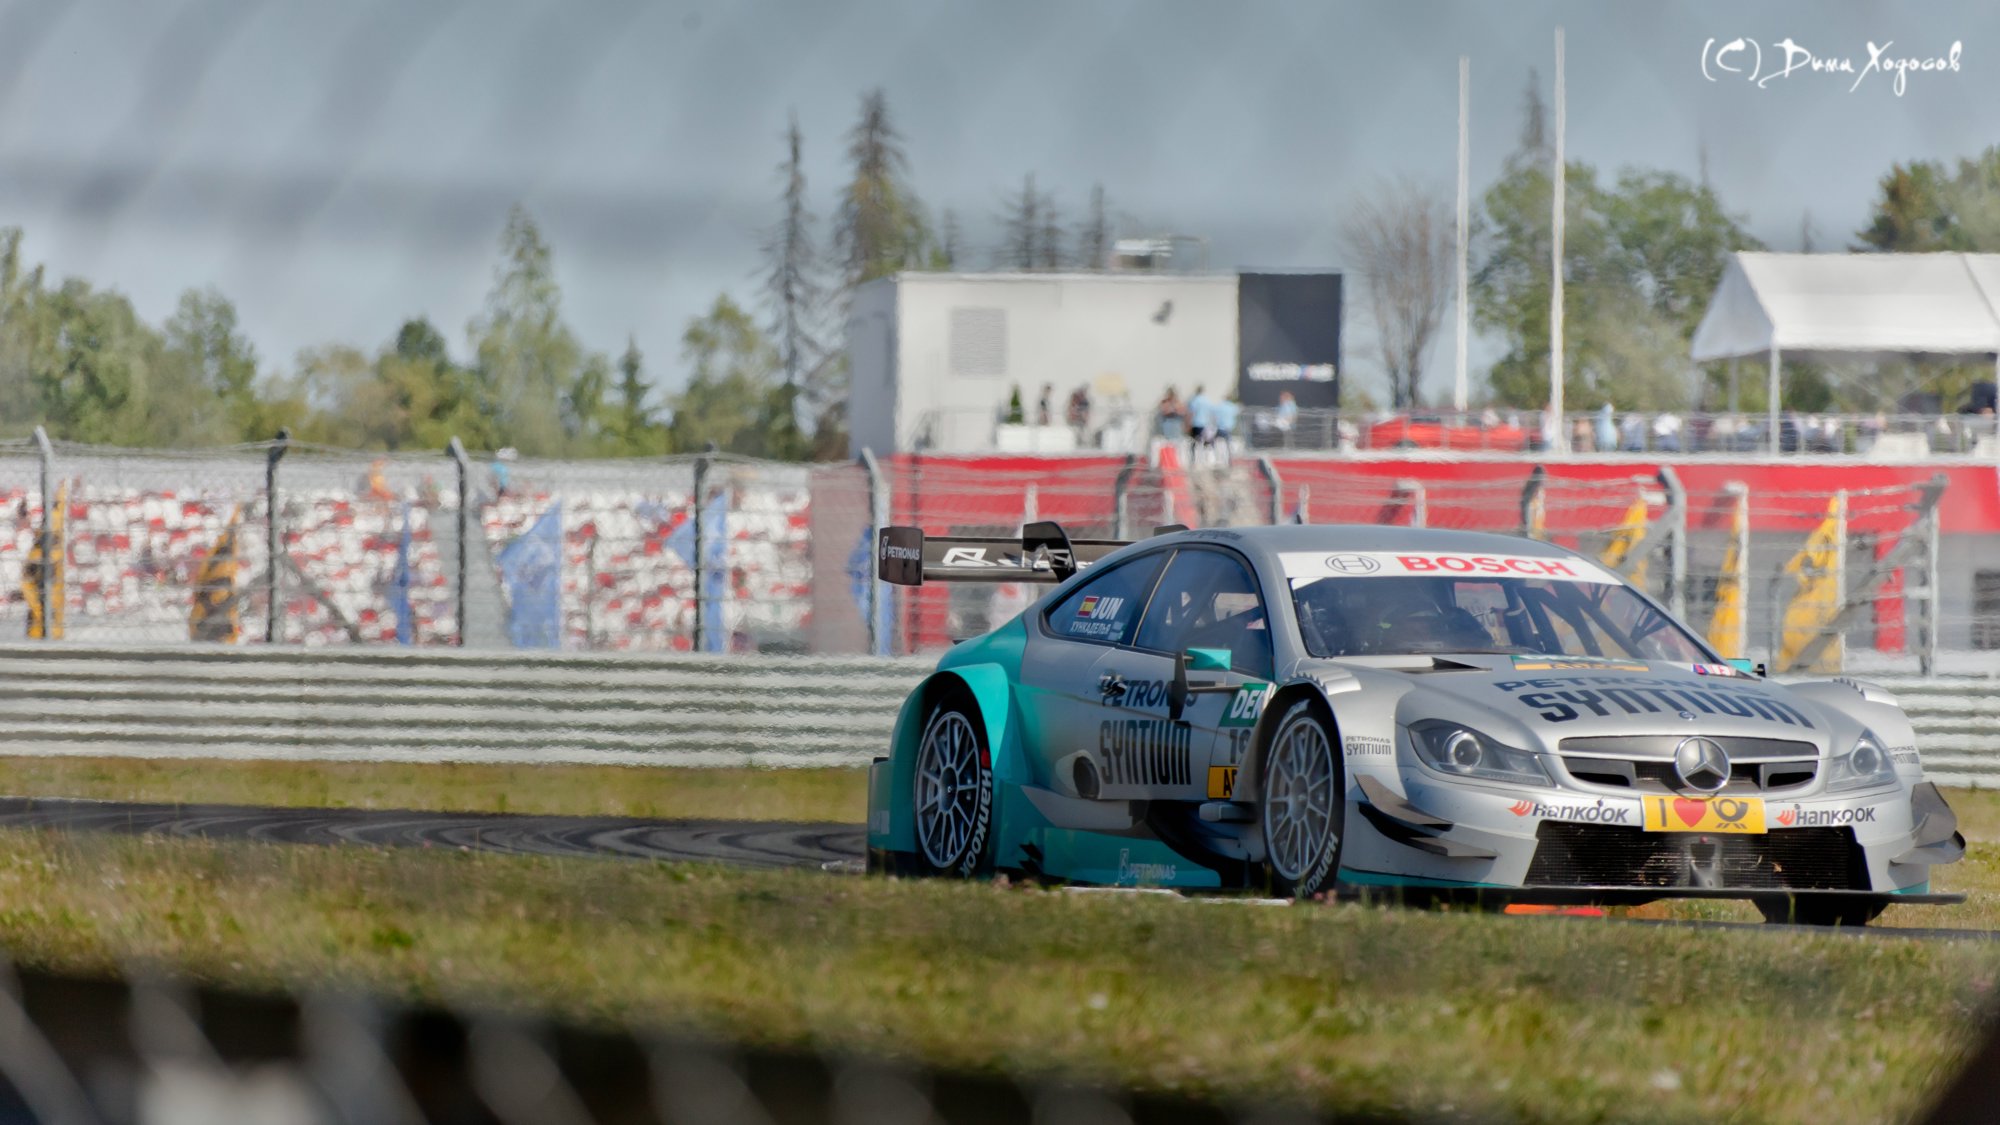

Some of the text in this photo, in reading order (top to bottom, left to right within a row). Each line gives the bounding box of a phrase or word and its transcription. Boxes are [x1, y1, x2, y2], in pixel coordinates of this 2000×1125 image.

[887, 545, 920, 561] PETRONAS
[1396, 555, 1579, 576] BOSCH
[1090, 597, 1124, 620] JUN
[1492, 675, 1771, 697] PETRONAS
[1517, 687, 1817, 730] SYNTIUM
[1345, 735, 1391, 744] PETRONAS
[1345, 743, 1392, 756] SYNTIUM
[1099, 719, 1192, 786] SYNTIUM
[1128, 862, 1177, 881] PETRONAS
